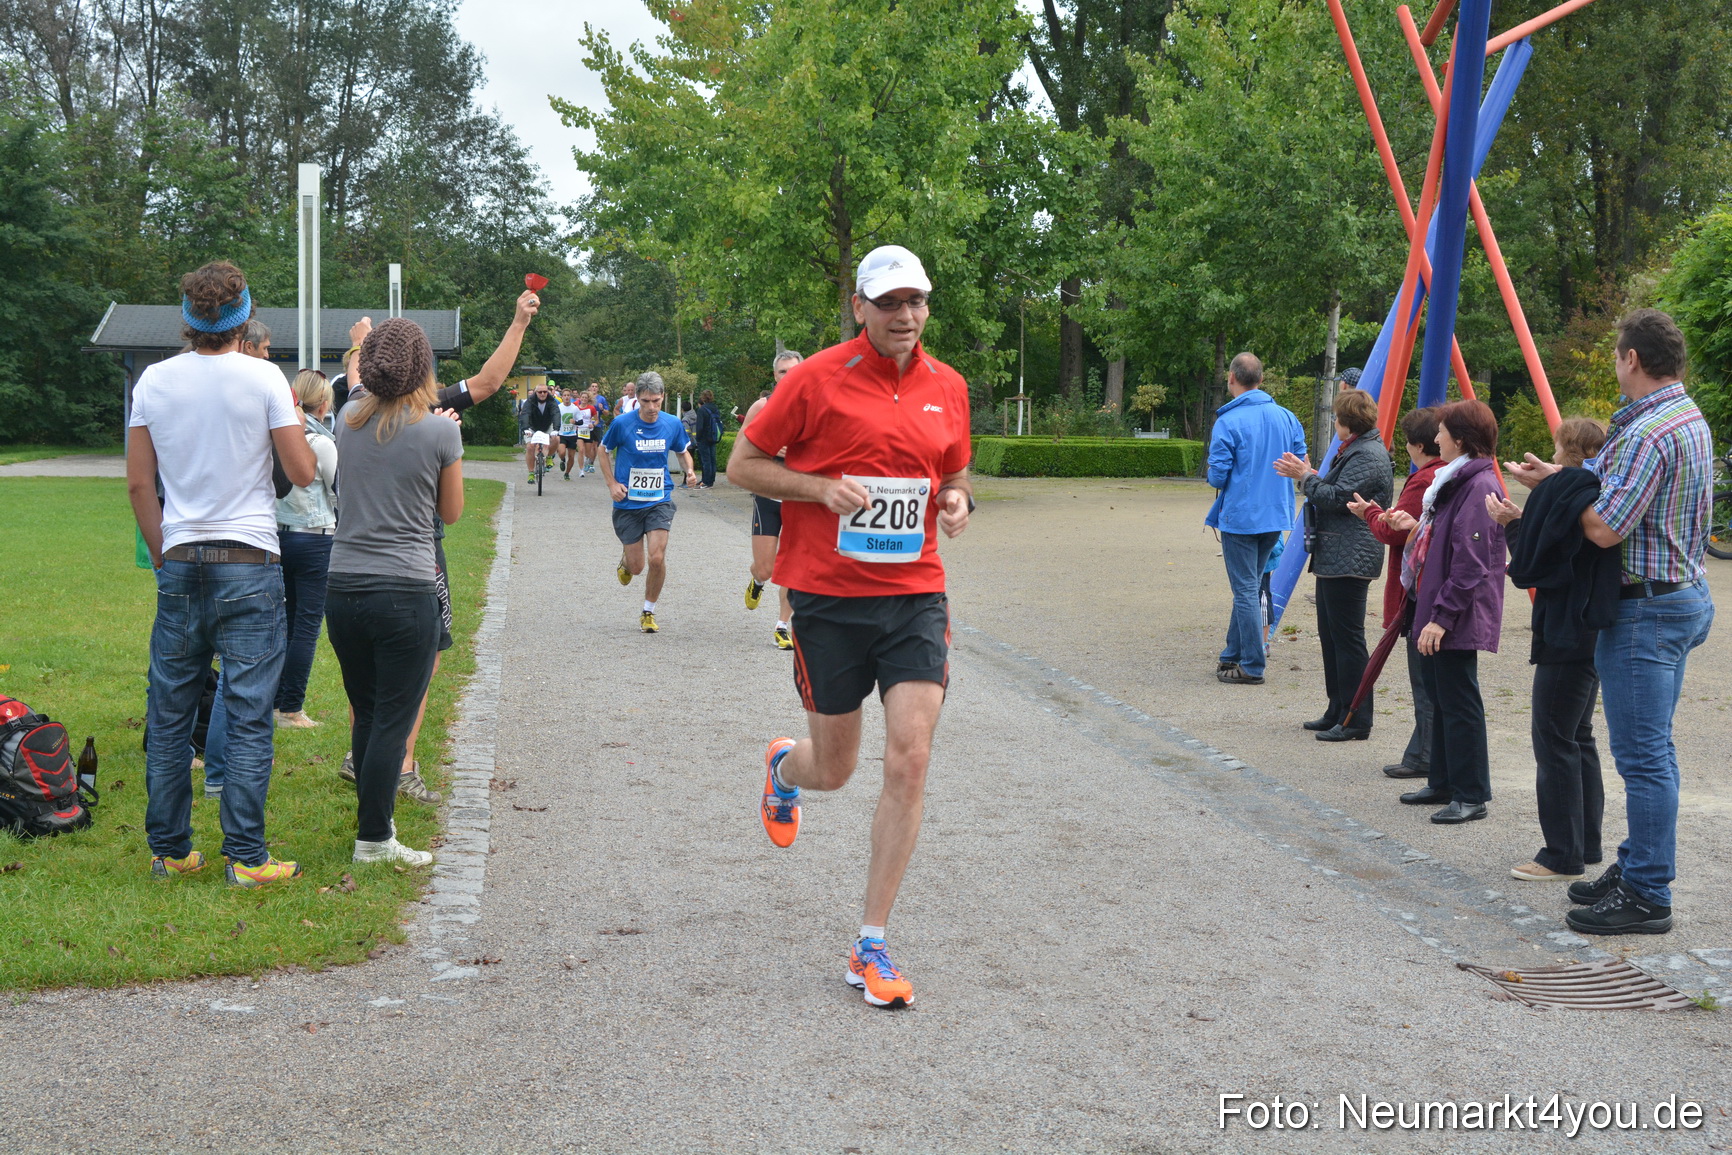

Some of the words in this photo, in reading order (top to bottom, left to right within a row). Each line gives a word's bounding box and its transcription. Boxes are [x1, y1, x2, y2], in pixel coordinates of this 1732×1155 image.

[635, 439, 666, 447] HUBER
[633, 476, 662, 489] 2870
[876, 486, 916, 495] Neumarkt
[866, 537, 903, 551] Stefan
